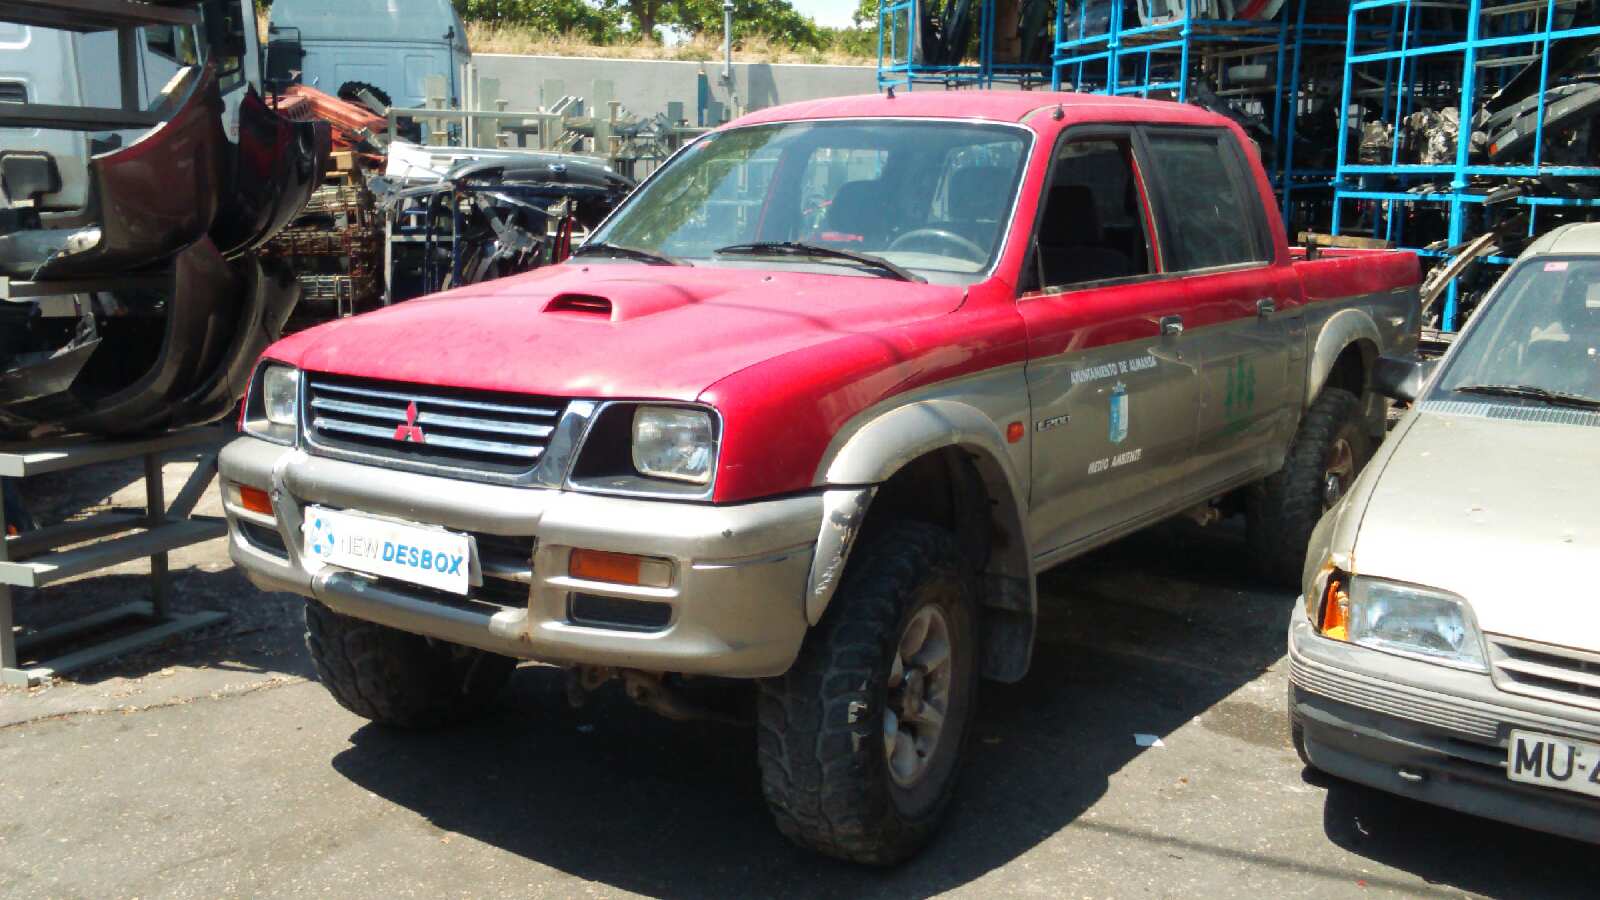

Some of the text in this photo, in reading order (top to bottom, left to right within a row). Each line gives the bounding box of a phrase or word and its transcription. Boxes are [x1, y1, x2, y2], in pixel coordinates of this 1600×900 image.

[1070, 362, 1118, 384] AYUNTAMIENTO
[1118, 360, 1128, 374] DE
[1087, 448, 1142, 475] MEDIO AMBIENTE
[381, 541, 464, 577] DESBOX
